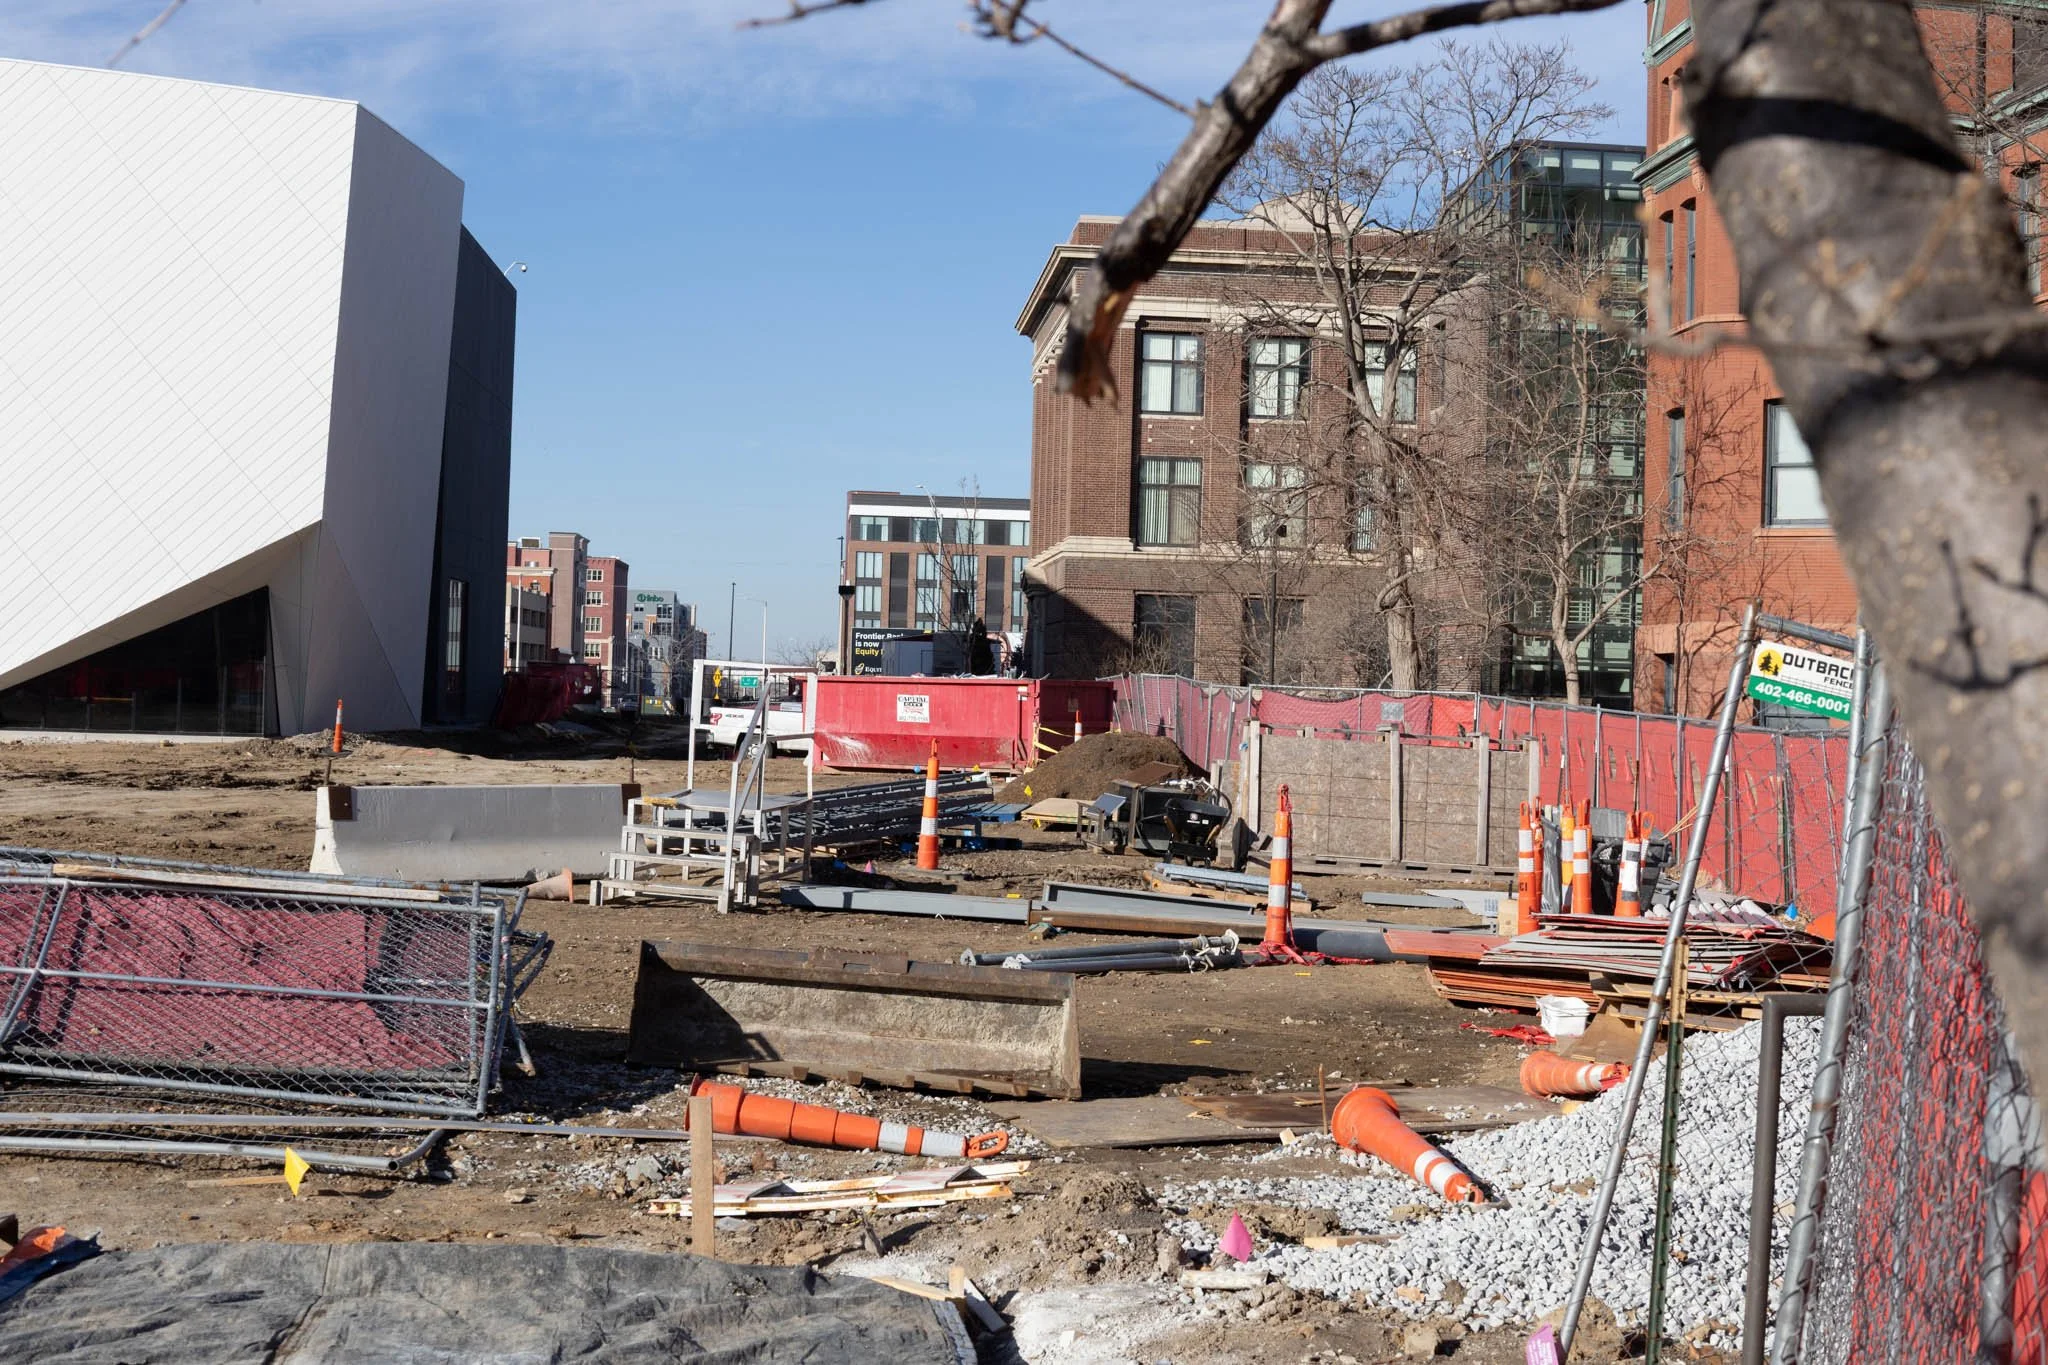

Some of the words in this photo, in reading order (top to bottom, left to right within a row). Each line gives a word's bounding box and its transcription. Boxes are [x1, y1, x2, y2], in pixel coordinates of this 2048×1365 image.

[855, 632, 885, 640] Frontier
[855, 648, 879, 656] Equity
[1755, 681, 1850, 714] 402-466-0001
